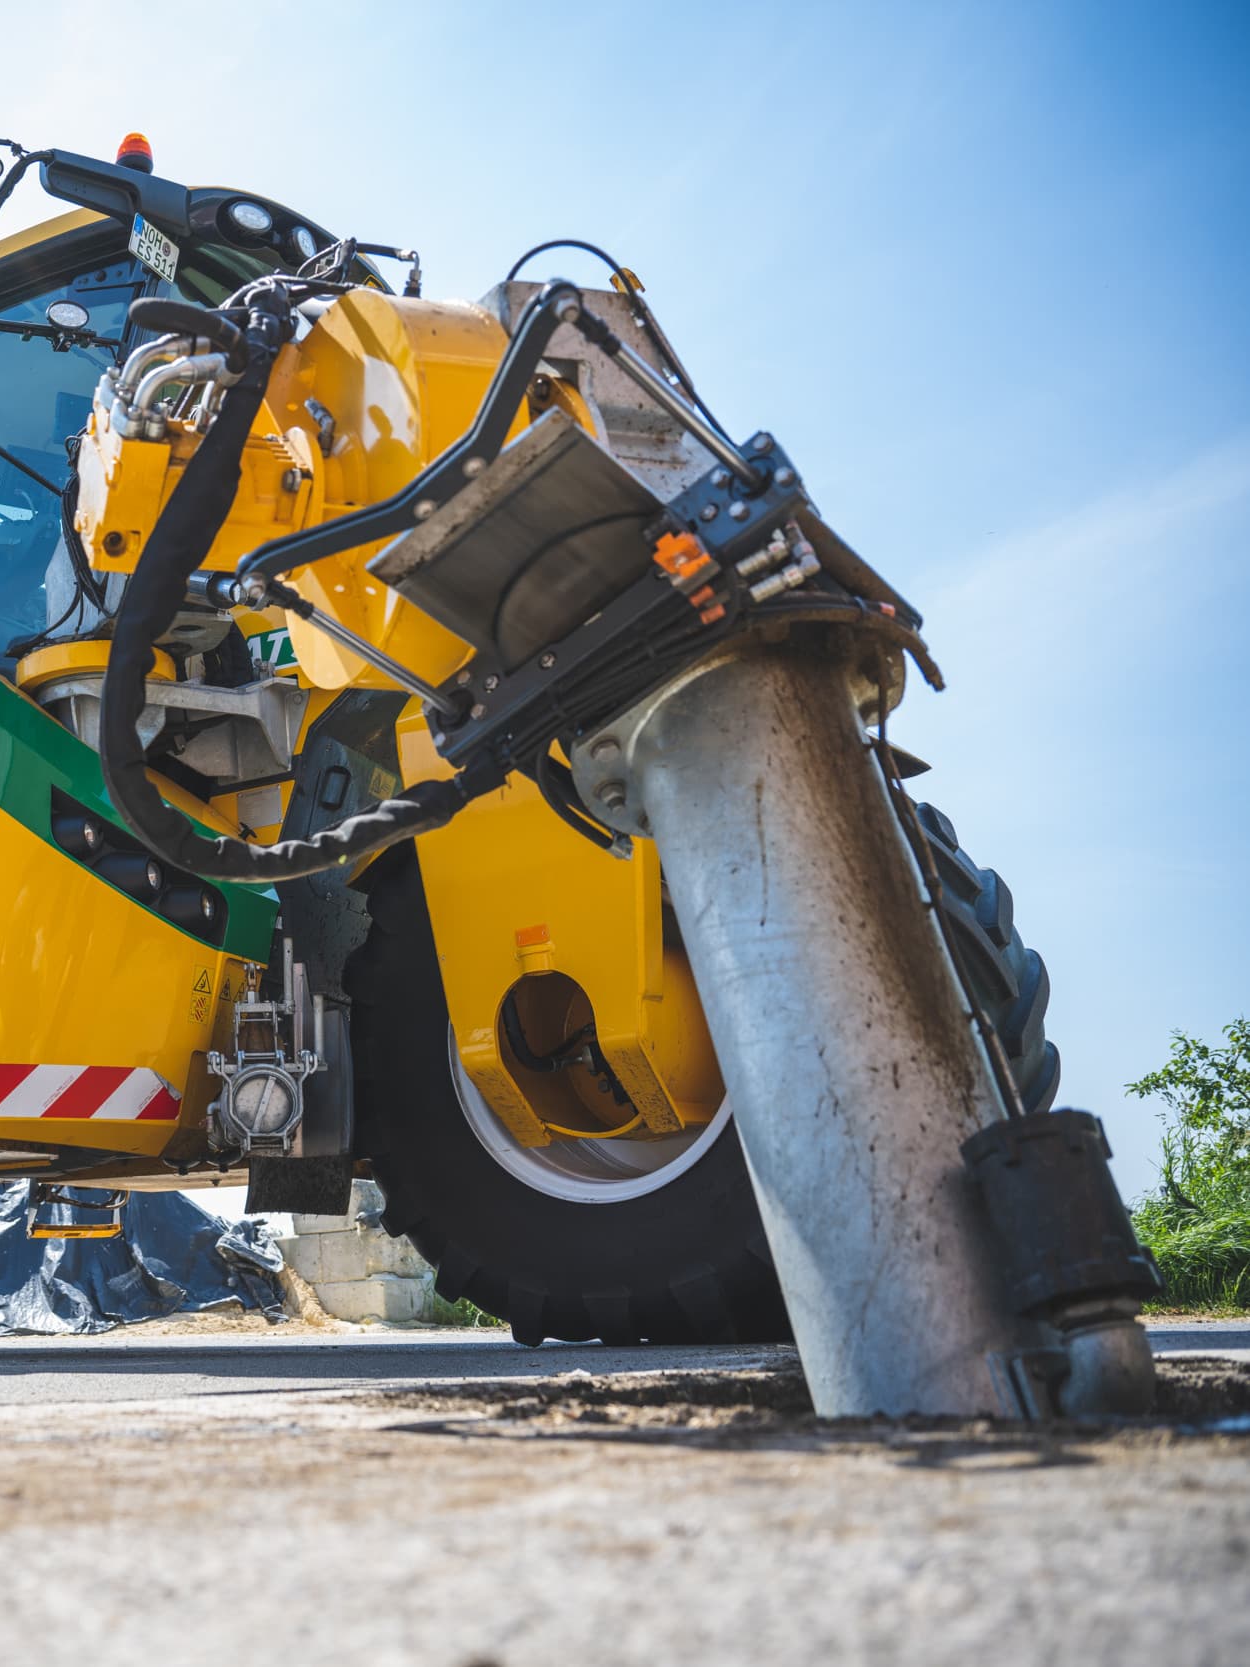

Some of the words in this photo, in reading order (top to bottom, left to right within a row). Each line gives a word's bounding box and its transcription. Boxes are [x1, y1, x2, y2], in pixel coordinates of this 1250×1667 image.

[141, 222, 163, 250] NOH
[137, 239, 153, 262] ES
[154, 252, 175, 280] 511
